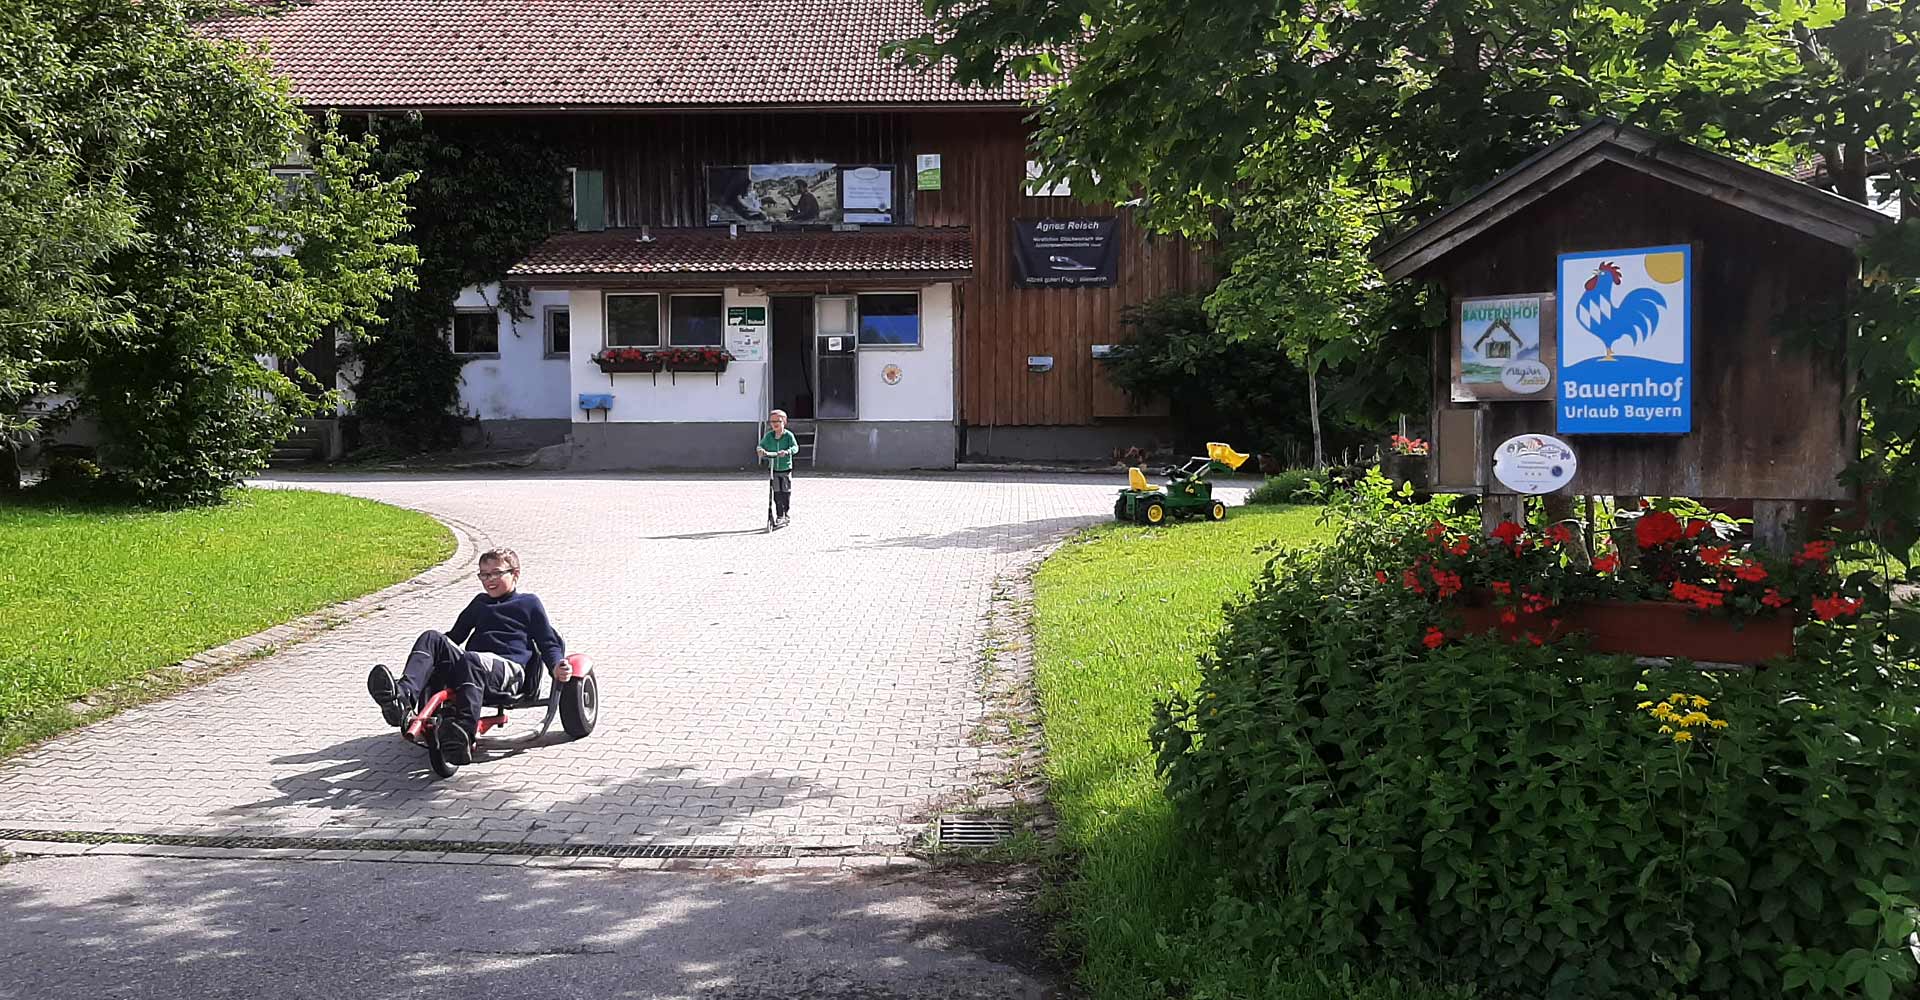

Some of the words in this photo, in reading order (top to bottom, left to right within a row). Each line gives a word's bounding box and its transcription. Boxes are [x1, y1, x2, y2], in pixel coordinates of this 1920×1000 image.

[1036, 221, 1065, 232] Agnes
[1067, 221, 1099, 230] Reisch
[1463, 305, 1539, 321] BAUERNHOF
[1563, 376, 1684, 402] Bauernhof
[1564, 404, 1619, 419] Urlaub
[1624, 404, 1682, 421] Bayern
